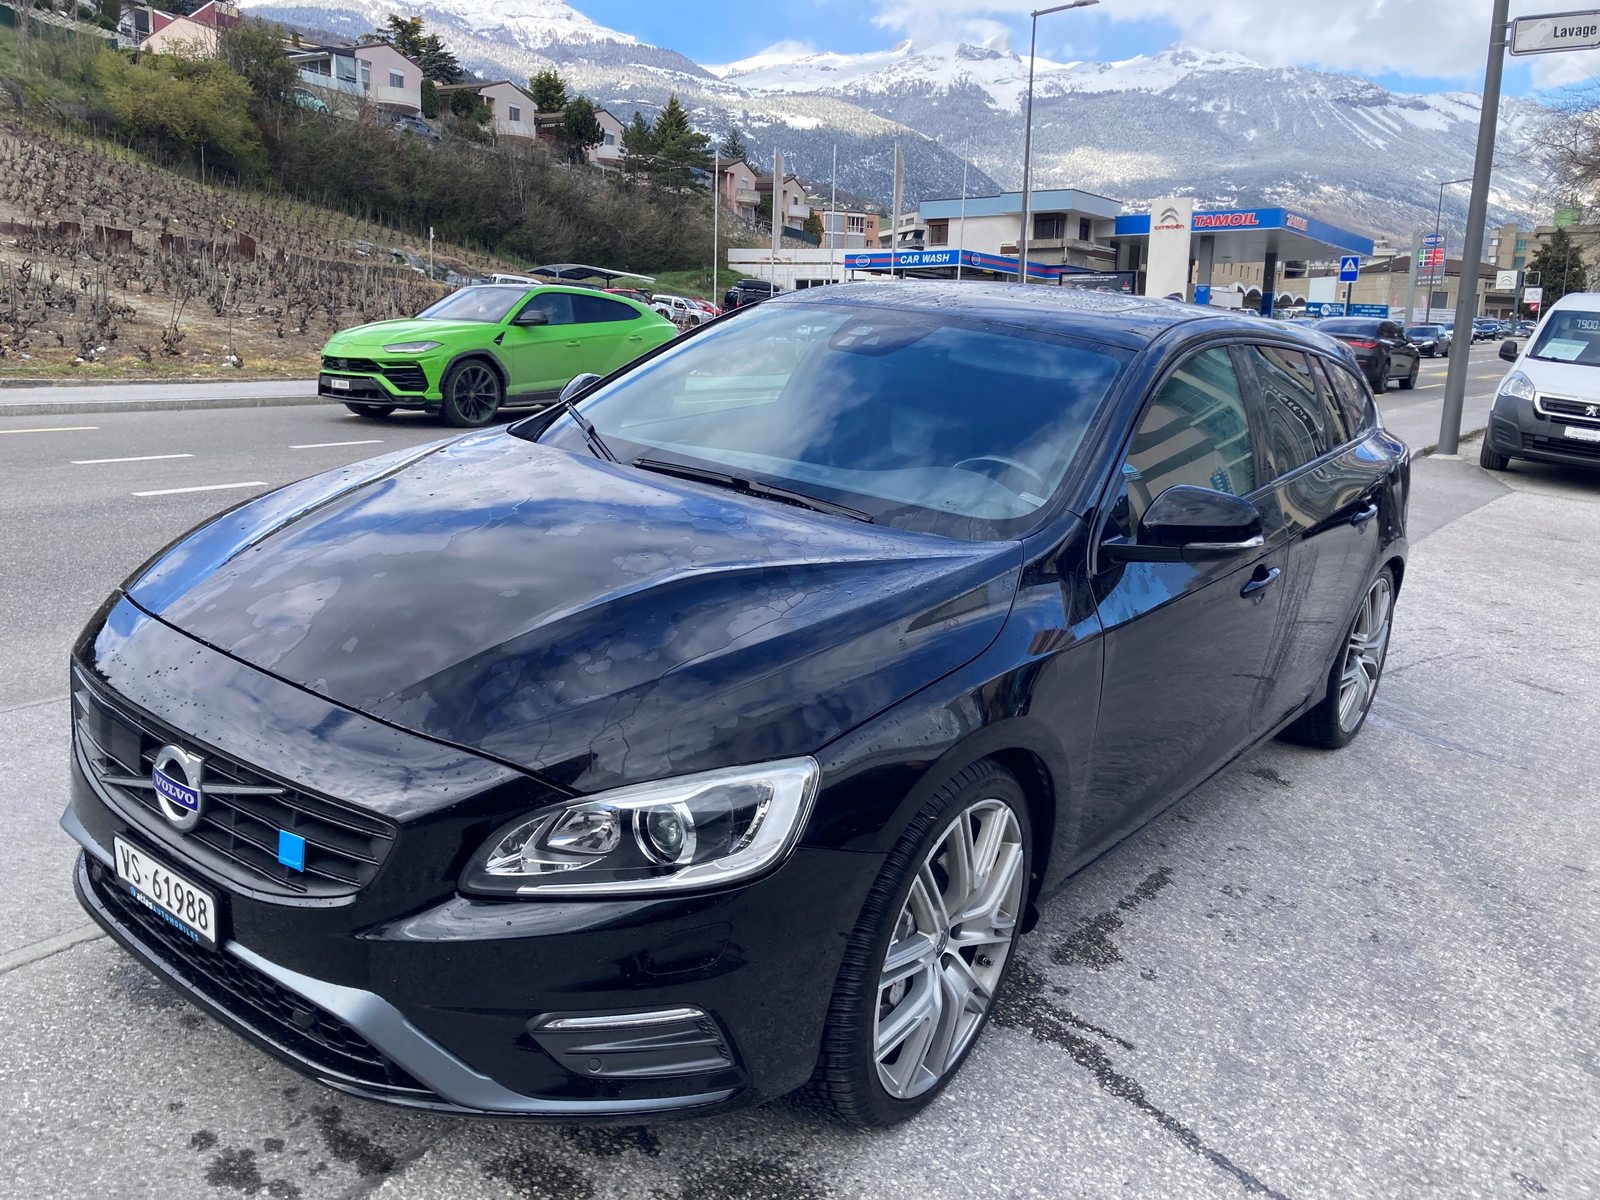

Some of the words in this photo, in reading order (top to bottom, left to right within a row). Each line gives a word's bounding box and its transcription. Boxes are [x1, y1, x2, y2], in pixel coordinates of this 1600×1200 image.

[1553, 25, 1597, 38] Lavage
[1193, 213, 1260, 228] TAMOIL
[900, 255, 919, 265] CAR
[922, 253, 950, 263] WASH
[154, 772, 195, 805] VOLVO
